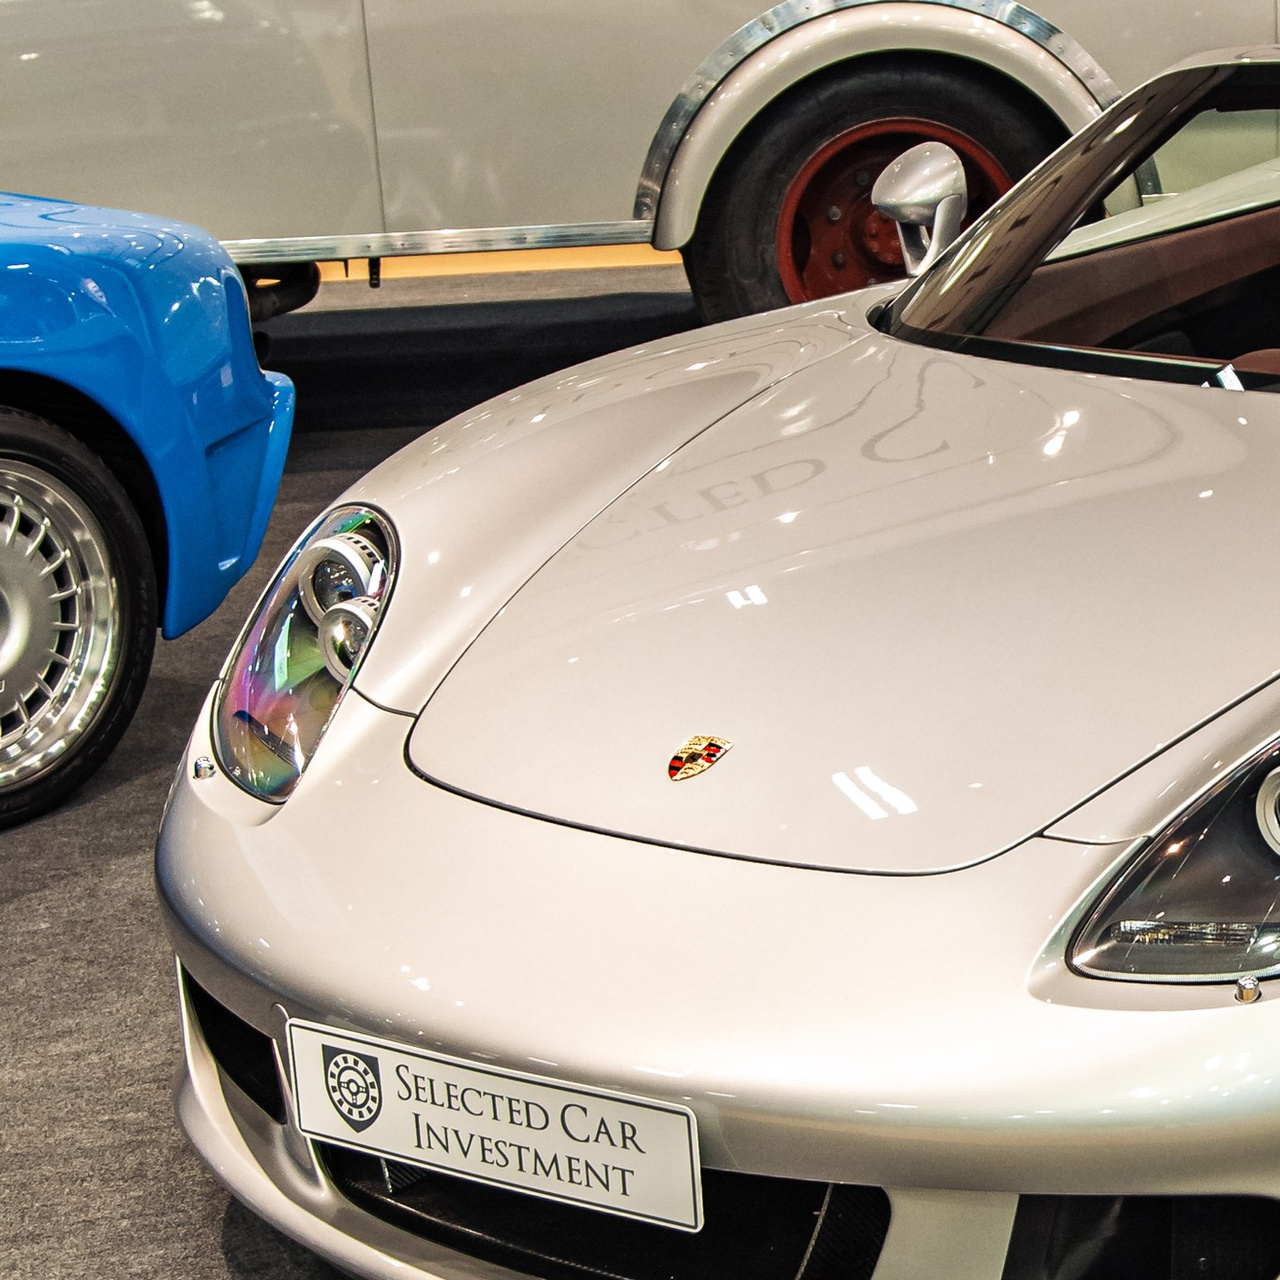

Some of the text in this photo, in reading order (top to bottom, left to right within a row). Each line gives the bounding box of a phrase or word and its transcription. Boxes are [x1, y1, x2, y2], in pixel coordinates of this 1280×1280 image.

[395, 1064, 646, 1154] SELECTED CAR
[412, 1112, 635, 1196] INVESTMENT
